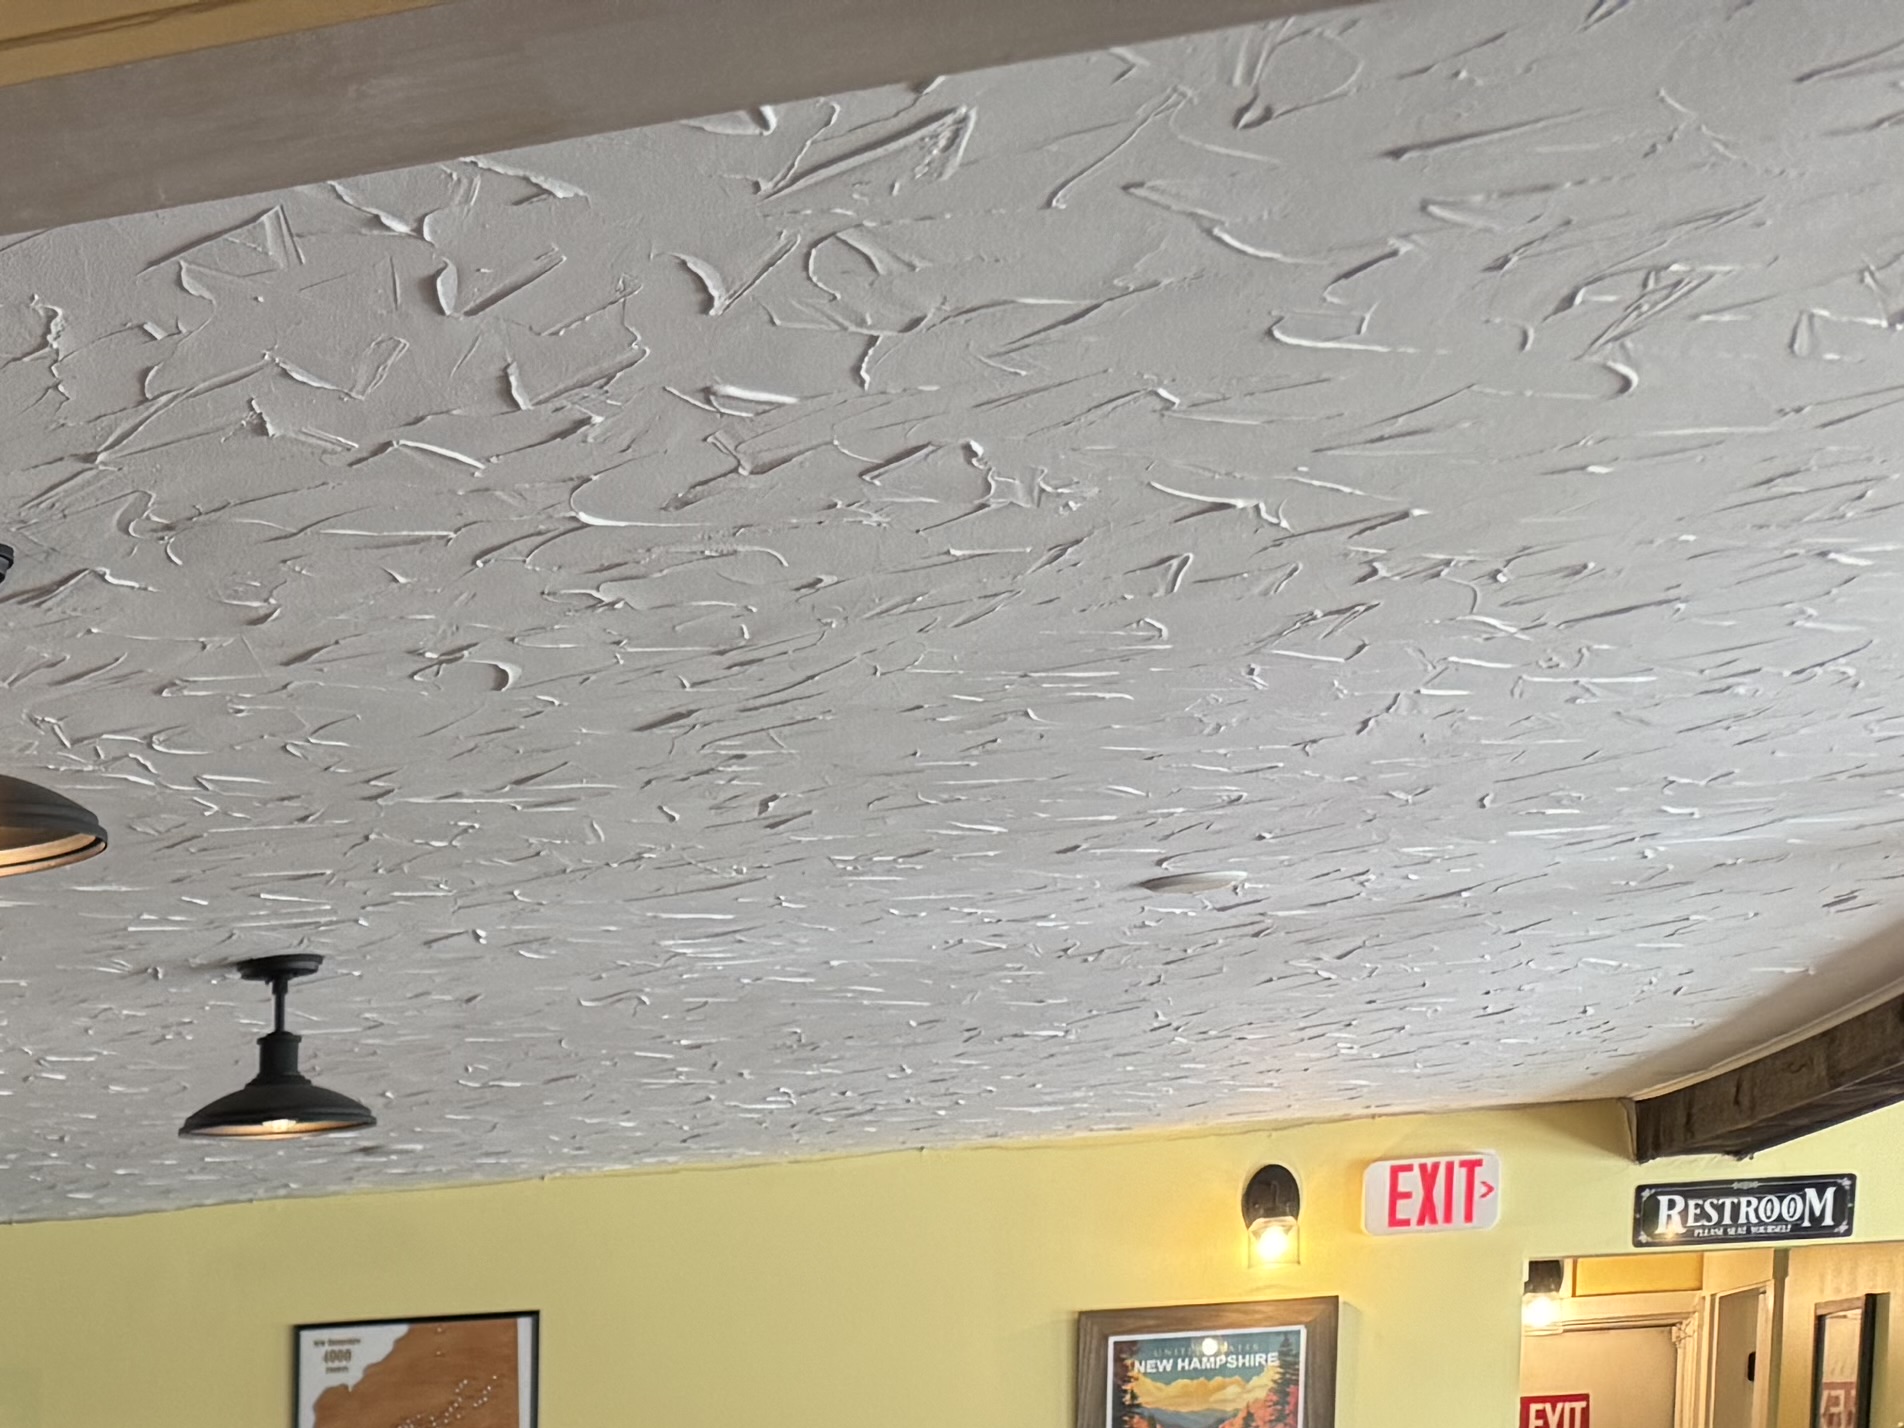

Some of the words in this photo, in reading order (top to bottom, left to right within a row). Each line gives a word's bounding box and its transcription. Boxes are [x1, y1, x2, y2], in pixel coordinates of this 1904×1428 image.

[1388, 1158, 1484, 1228] EXIT
[1654, 1187, 1837, 1235] RESTROOM
[1134, 1358, 1174, 1373] NEW
[1177, 1352, 1279, 1371] HAMPSHIRE
